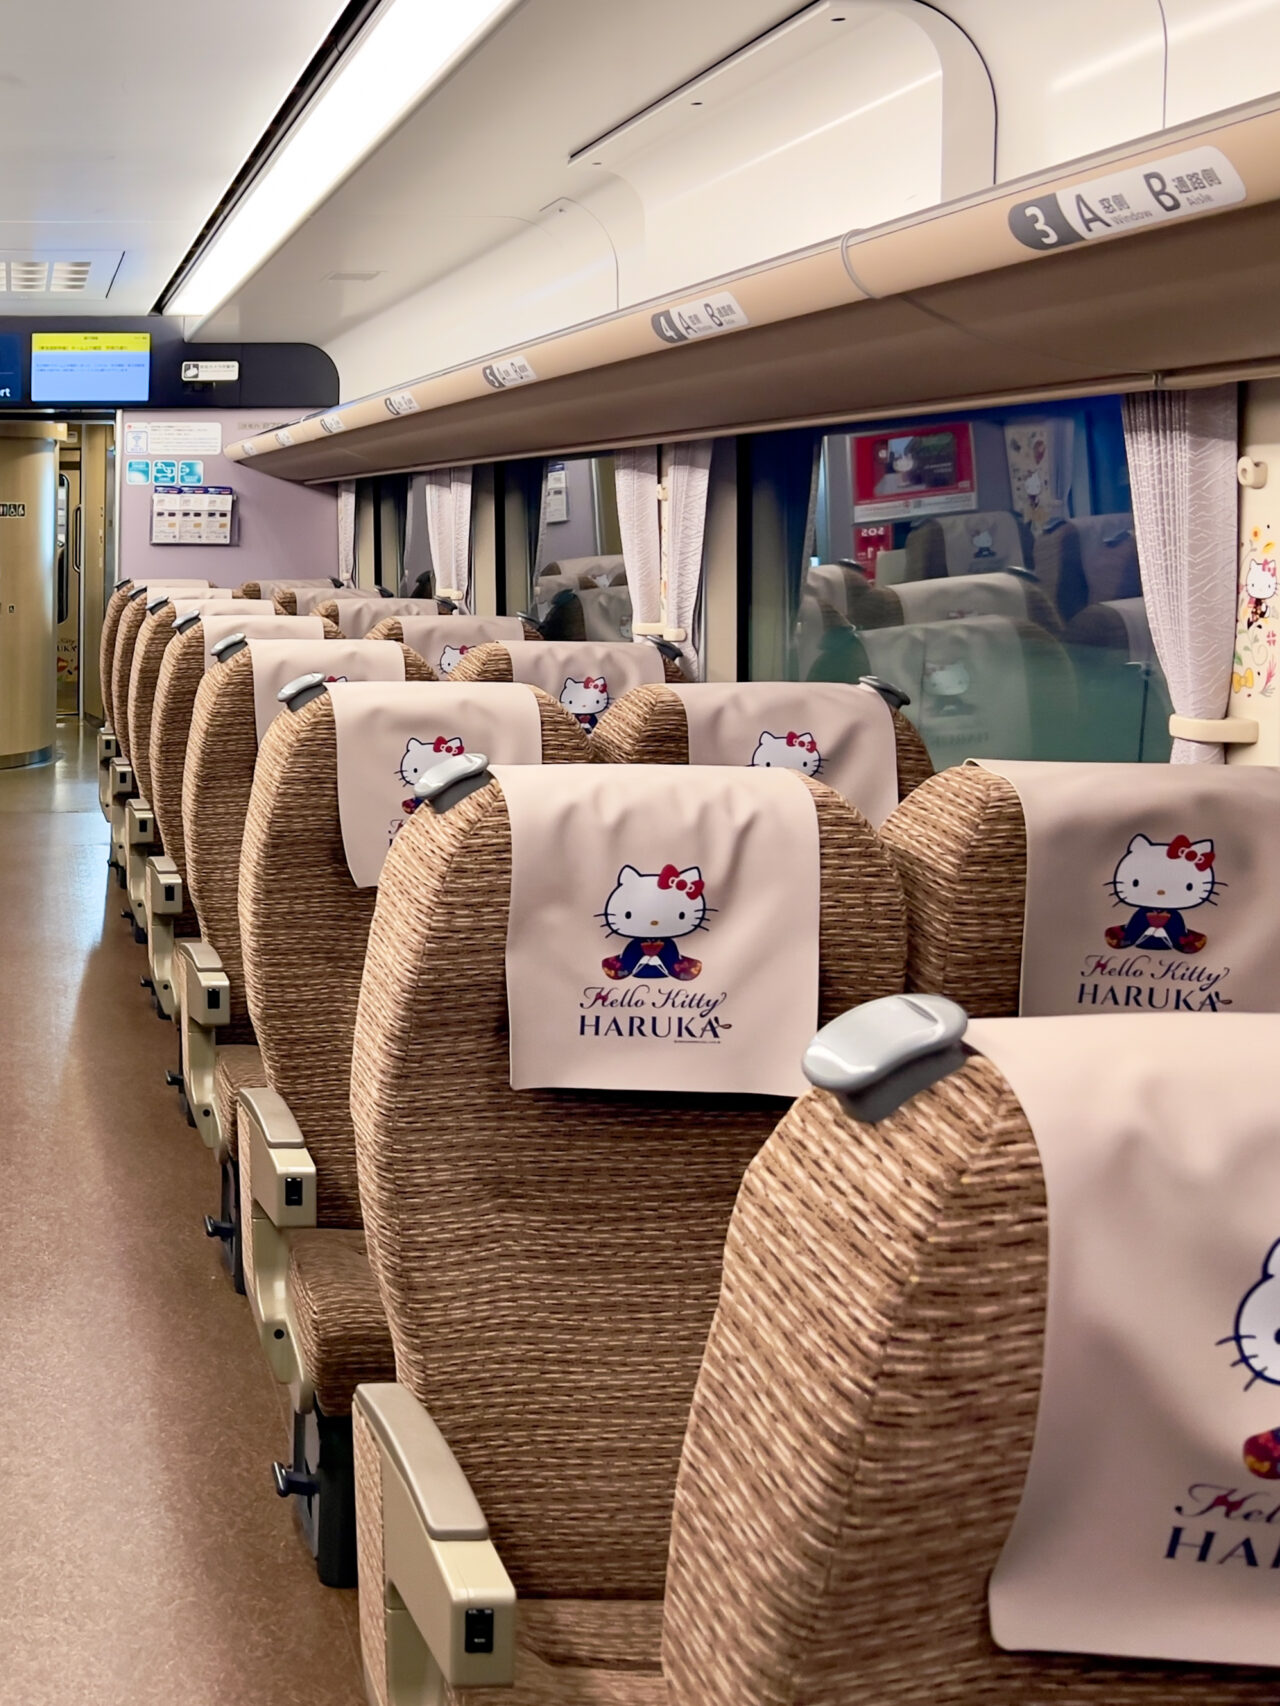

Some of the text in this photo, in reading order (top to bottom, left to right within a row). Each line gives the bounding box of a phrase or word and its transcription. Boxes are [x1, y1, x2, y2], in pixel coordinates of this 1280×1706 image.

[1143, 171, 1181, 213] B
[1171, 167, 1222, 195] 通路側
[1098, 194, 1131, 215] 窓側
[1185, 194, 1215, 208] Aisle
[1024, 193, 1113, 245] 3 A
[1110, 208, 1153, 226] Window
[660, 316, 678, 339] 4
[677, 311, 698, 335] A
[704, 303, 724, 327] B
[1080, 954, 1230, 992] Hello Kitty
[579, 984, 728, 1018] Hello Kitty
[1078, 983, 1219, 1012] HARUKA
[579, 1015, 721, 1039] HARUKA
